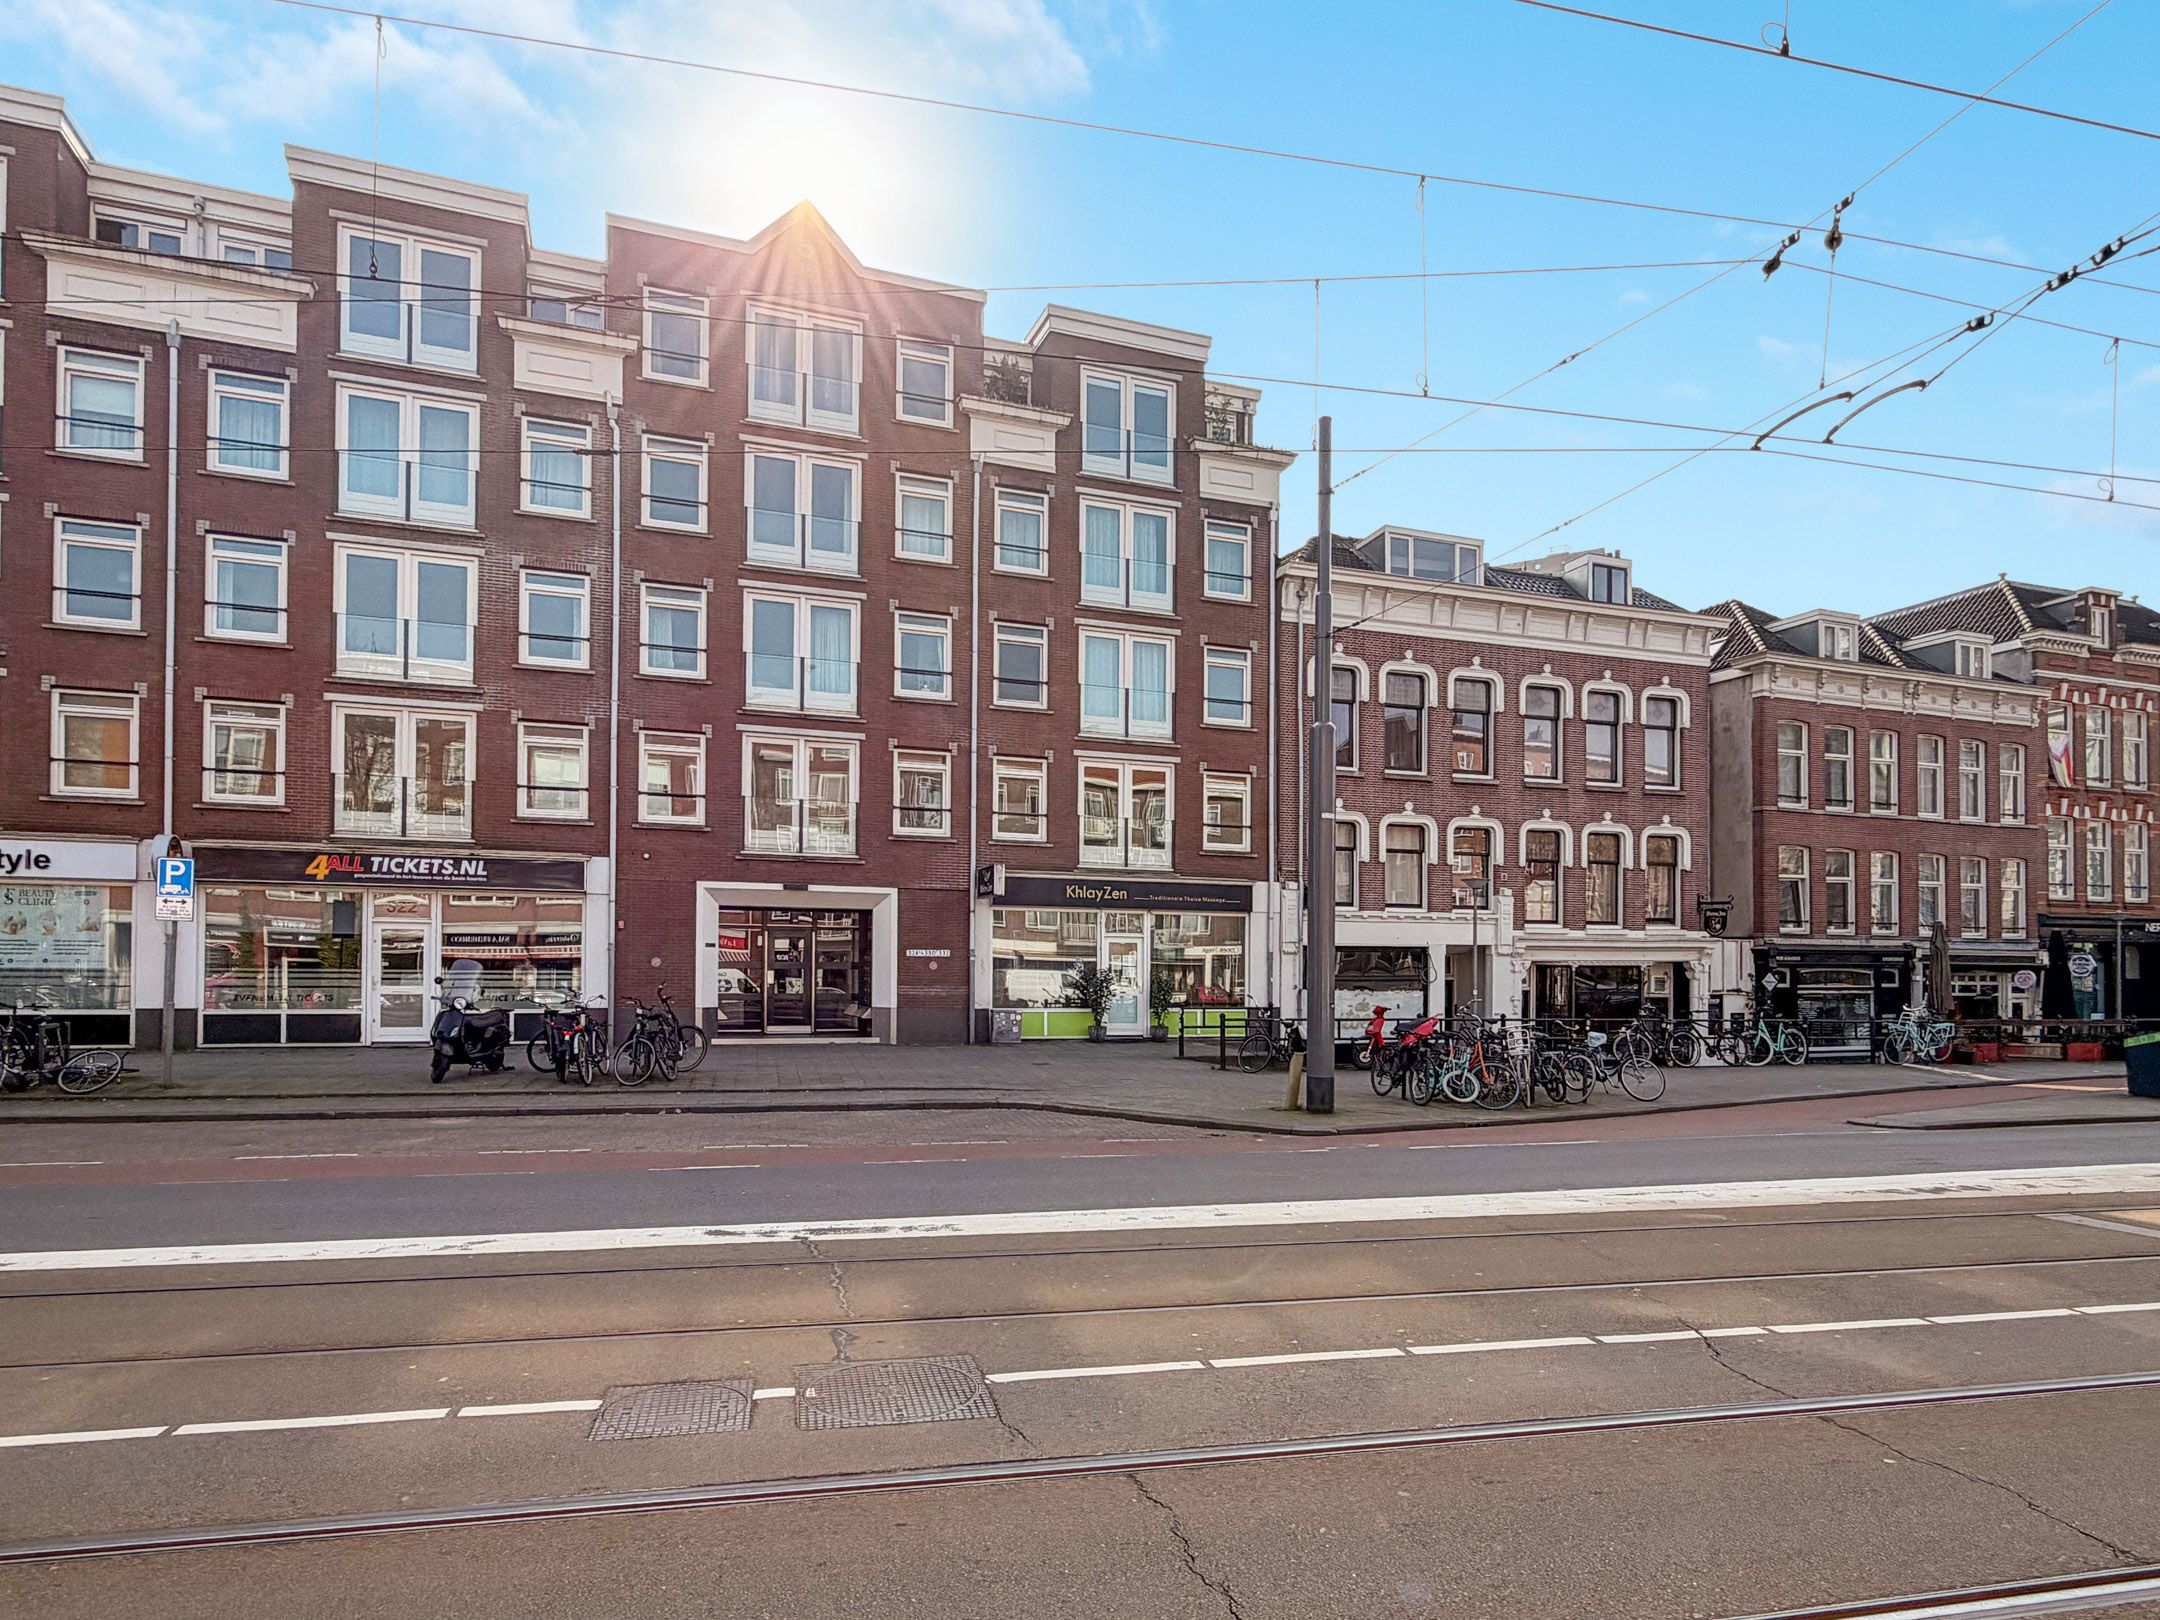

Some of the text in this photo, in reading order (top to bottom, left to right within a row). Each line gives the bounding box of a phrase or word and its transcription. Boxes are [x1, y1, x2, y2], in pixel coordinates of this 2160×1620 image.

[165, 860, 186, 884] P
[370, 856, 488, 876] TICKETS.NL
[18, 888, 56, 898] BEAUTY
[1066, 885, 1128, 902] KhlayZen
[18, 897, 56, 906] CLINIC
[296, 994, 334, 1002] TICTS
